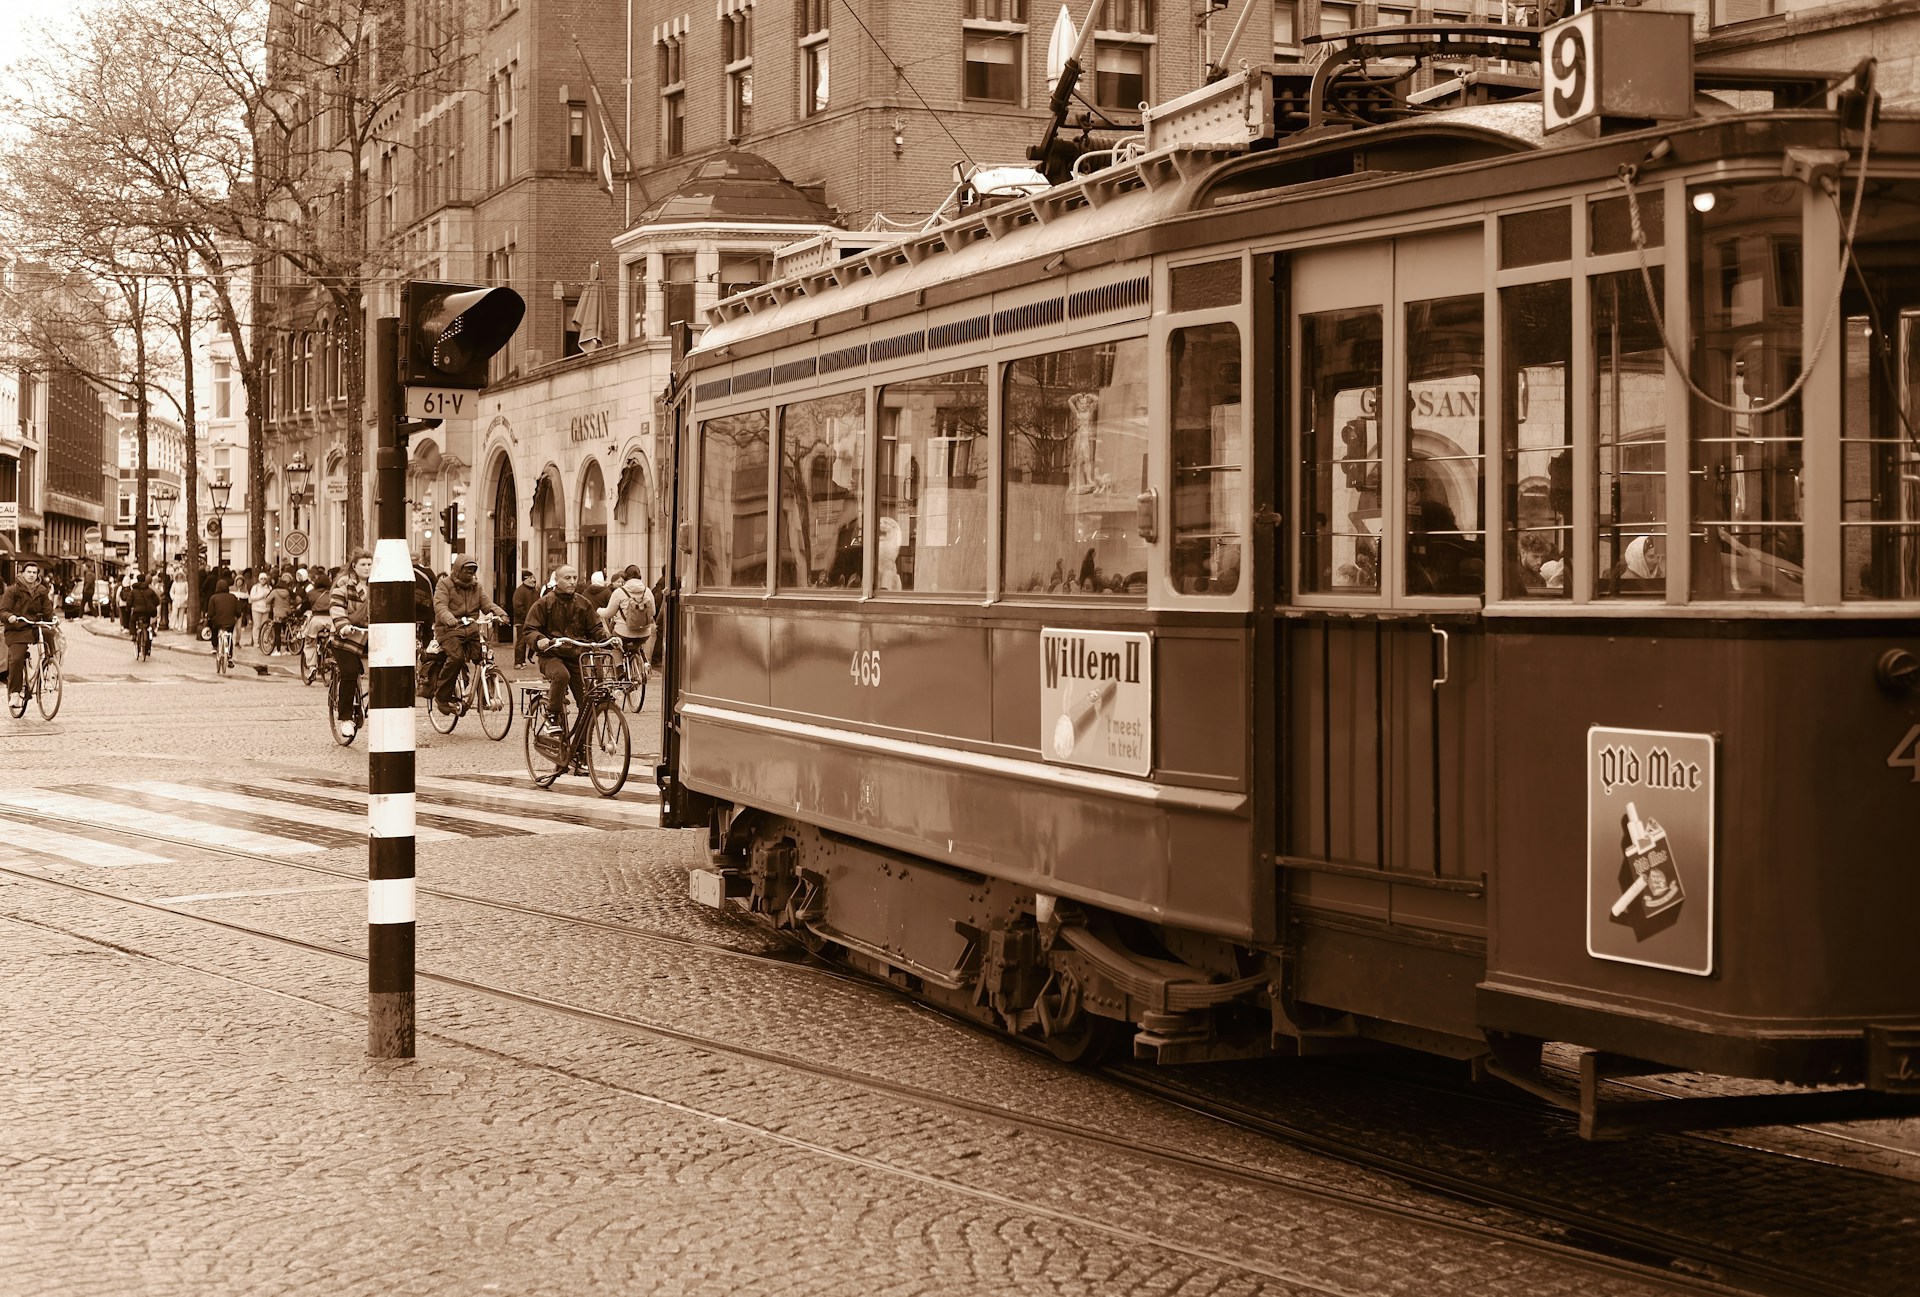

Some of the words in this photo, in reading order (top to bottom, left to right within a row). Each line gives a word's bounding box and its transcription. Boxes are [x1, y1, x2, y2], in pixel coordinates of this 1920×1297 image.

[1551, 25, 1587, 119] 9
[424, 392, 464, 415] 61-V
[1360, 389, 1478, 417] GSAN
[571, 410, 609, 443] GASSAN
[850, 650, 881, 688] 465
[1044, 637, 1121, 689] Willem
[1125, 641, 1141, 683] II
[1108, 736, 1117, 757] in
[1118, 733, 1143, 760] trek!
[1599, 744, 1641, 795] Old
[1645, 746, 1702, 792] Mac
